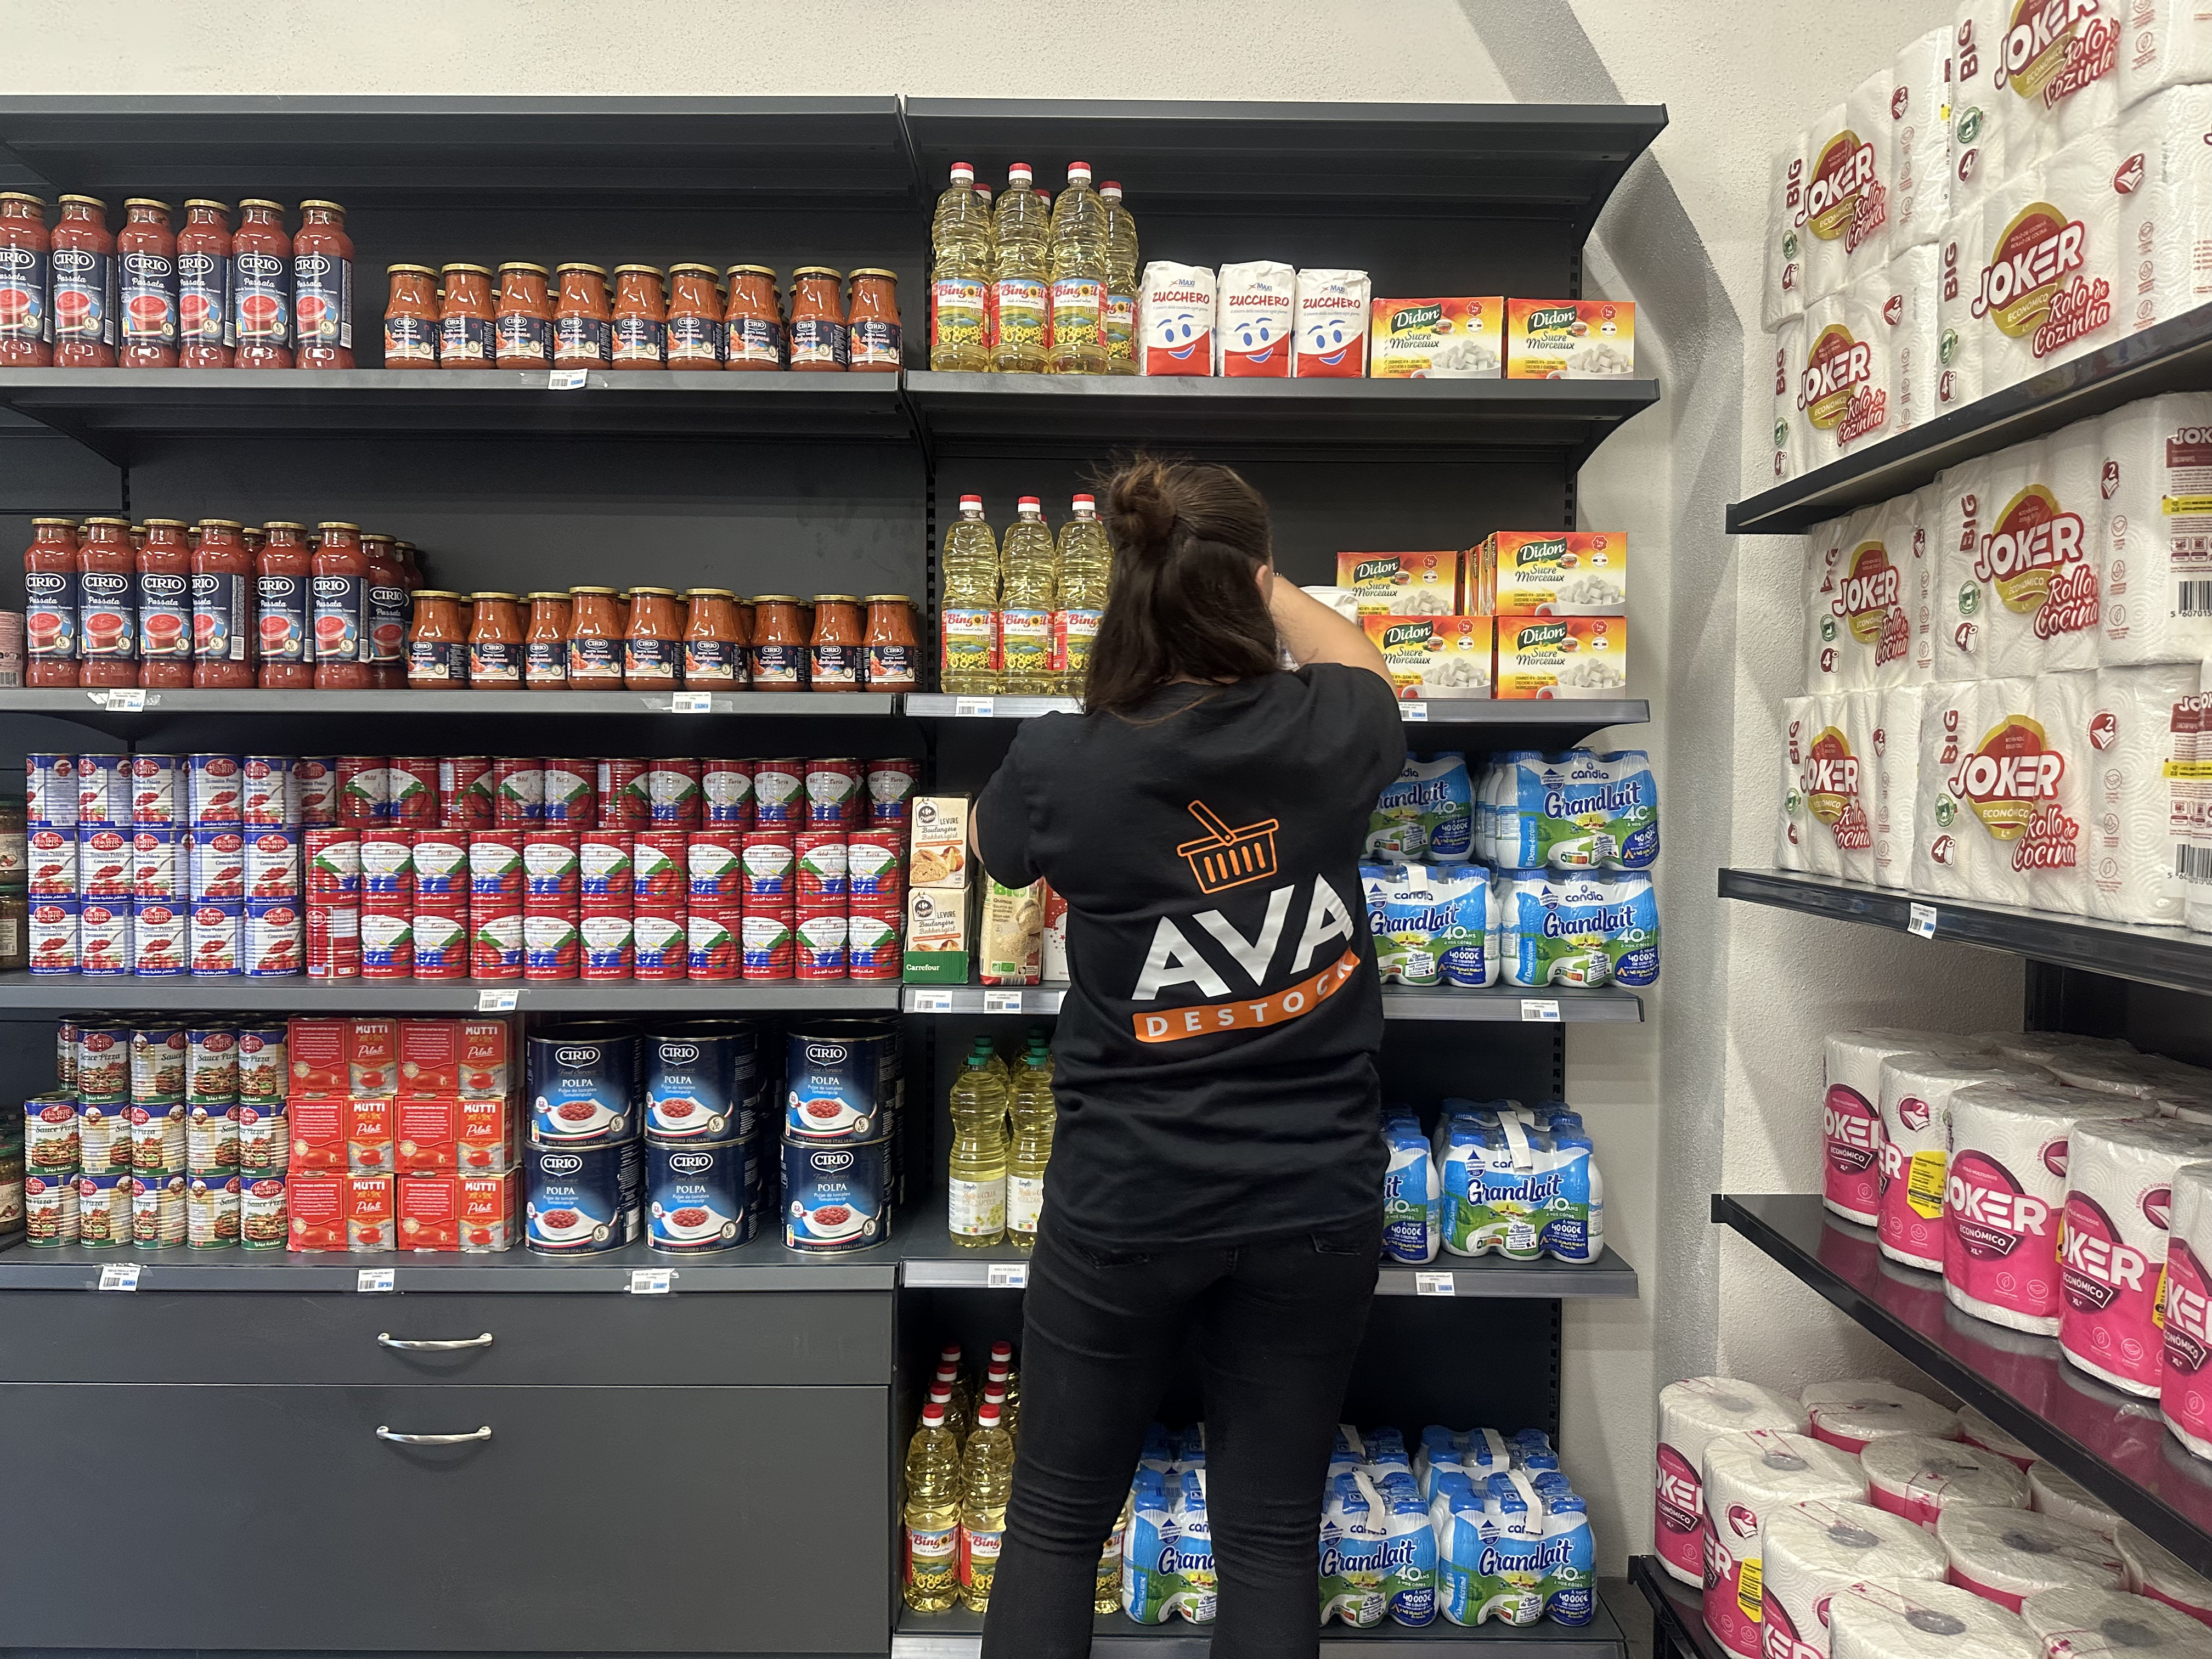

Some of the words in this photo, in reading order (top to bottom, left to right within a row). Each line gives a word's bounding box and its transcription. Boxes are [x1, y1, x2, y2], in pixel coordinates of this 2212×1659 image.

[1959, 19, 1978, 82] BIG
[1786, 159, 1802, 208] BIG
[1796, 144, 1873, 227] JOKER
[128, 257, 167, 271] CIRIO
[241, 257, 278, 271] CIRIO
[295, 258, 325, 270] CIRIO
[1972, 223, 2083, 318] JOKER
[1944, 241, 1957, 302] BIG
[132, 277, 165, 289] Passata
[244, 278, 275, 287] Passata
[1152, 291, 1210, 304] ZUCCHERO
[1229, 295, 1289, 307] ZUCCHERO
[1302, 296, 1361, 309] ZUCCHERO
[2049, 278, 2085, 323] Rolo
[2094, 280, 2107, 298] de
[1395, 309, 1439, 328] Didon
[1531, 311, 1575, 328] Didon
[1404, 330, 1431, 341] Sucre
[1541, 331, 1566, 342] Sucre
[2034, 304, 2108, 357] Cozinha
[1390, 337, 1440, 349] Morceaux
[1526, 338, 1575, 350] Morceaux
[1798, 345, 1868, 411] JOKER
[1848, 387, 1870, 421] Rolo
[1875, 391, 1884, 405] de
[1838, 407, 1884, 446] Cozinha
[1960, 494, 1977, 551] BIG
[1520, 543, 1565, 561] Didon
[1976, 515, 2081, 582] JOKER
[1358, 561, 1397, 579] Didon
[1515, 570, 1564, 583] Morceaux
[1531, 564, 1556, 576] Sucre
[27, 577, 60, 588] CIRIO
[85, 577, 123, 588] CIRIO
[144, 578, 182, 589] CIRIO
[1367, 580, 1390, 591] Sucre
[2049, 565, 2090, 603] Rollo
[373, 590, 403, 601] CIRIO
[1353, 586, 1397, 597] Morceaux
[1833, 568, 1898, 616] JOKER
[88, 596, 120, 605] Passata
[147, 597, 179, 606] Passata
[2035, 598, 2098, 639] Cocina
[1521, 627, 1565, 644] Didon
[1516, 653, 1565, 666] Morceaux
[1532, 648, 1557, 659] Sucre
[2105, 717, 2113, 730] 2
[1940, 710, 1959, 764] BIG
[1571, 770, 1609, 780] candia
[1949, 753, 2062, 799] JOKER
[1544, 782, 1641, 819] GrandLait
[940, 817, 958, 825] LEVURE
[2026, 806, 2062, 838] Rollo
[2064, 822, 2076, 837] de
[922, 832, 958, 840] Bakkersgist
[1934, 840, 1944, 855] 4
[2013, 838, 2076, 872] Cocina
[1566, 891, 1604, 901] candia
[937, 910, 956, 919] LEVURE
[1369, 904, 1460, 935] GrandLait
[919, 919, 954, 928] Boulangère
[1543, 906, 1635, 938] GrandLait
[919, 926, 956, 934] Bakkersgist
[1131, 872, 1355, 1001] AVA
[1441, 926, 1466, 940] 40
[1146, 956, 1354, 1037] DESTOCK
[356, 1025, 388, 1034] MUTTI
[465, 1026, 498, 1035] MUTTI
[358, 1045, 385, 1058] Pelati
[468, 1047, 495, 1058] Pelati
[560, 1051, 595, 1060] CIRIO
[662, 1047, 694, 1057] CIRIO
[809, 1048, 842, 1058] CIRIO
[664, 1076, 692, 1084] POLPA
[811, 1076, 839, 1085] POLPA
[354, 1103, 385, 1112] MUTTI
[464, 1104, 496, 1113] MUTTI
[1915, 1102, 1925, 1115] 2
[356, 1123, 382, 1136] Pelati
[815, 1155, 849, 1165] CIRIO
[1830, 1146, 1865, 1163] ECONÓMICO
[674, 1157, 708, 1167] CIRIO
[353, 1181, 385, 1190] MUTTI
[465, 1182, 496, 1191] MUTTI
[676, 1185, 706, 1194] POLPA
[817, 1183, 847, 1192] POLPA
[1467, 1174, 1563, 1205] GrandLait
[356, 1201, 382, 1214] Pelati
[1542, 1197, 1568, 1212] 40
[1944, 1175, 2047, 1236] JOKER
[1959, 1224, 2006, 1247] ECONÓMICO
[2063, 1272, 2103, 1300] ECONÓMICO
[1321, 1538, 1417, 1577] GrandLait
[1479, 1538, 1573, 1577] GrandLait
[1395, 1566, 1421, 1581] 40
